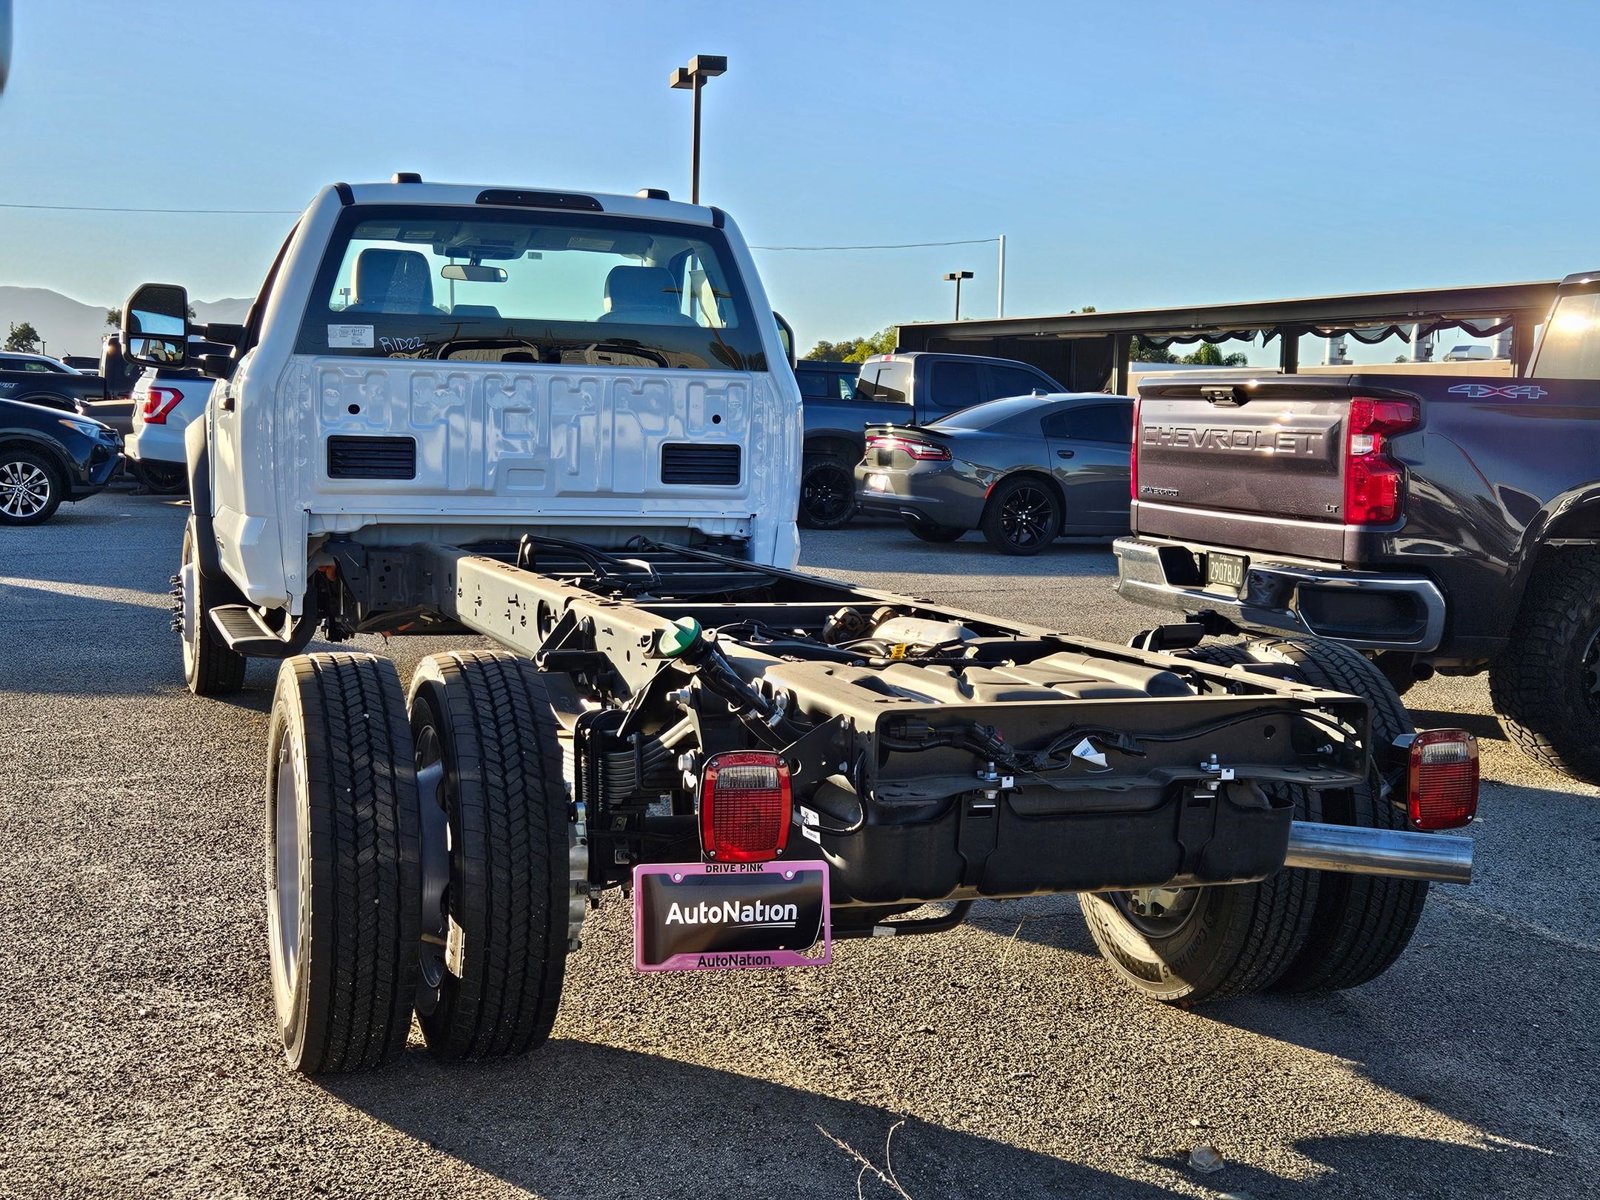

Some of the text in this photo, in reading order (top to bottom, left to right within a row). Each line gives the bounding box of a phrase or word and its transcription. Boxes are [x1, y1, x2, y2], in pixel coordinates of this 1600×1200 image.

[1142, 426, 1323, 454] CHEVROLET
[1325, 503, 1339, 513] LT
[1210, 561, 1241, 584] 29078J2
[705, 863, 764, 873] DRIVE PINK
[665, 900, 798, 925] AutoNation
[697, 954, 773, 968] AutoNation
